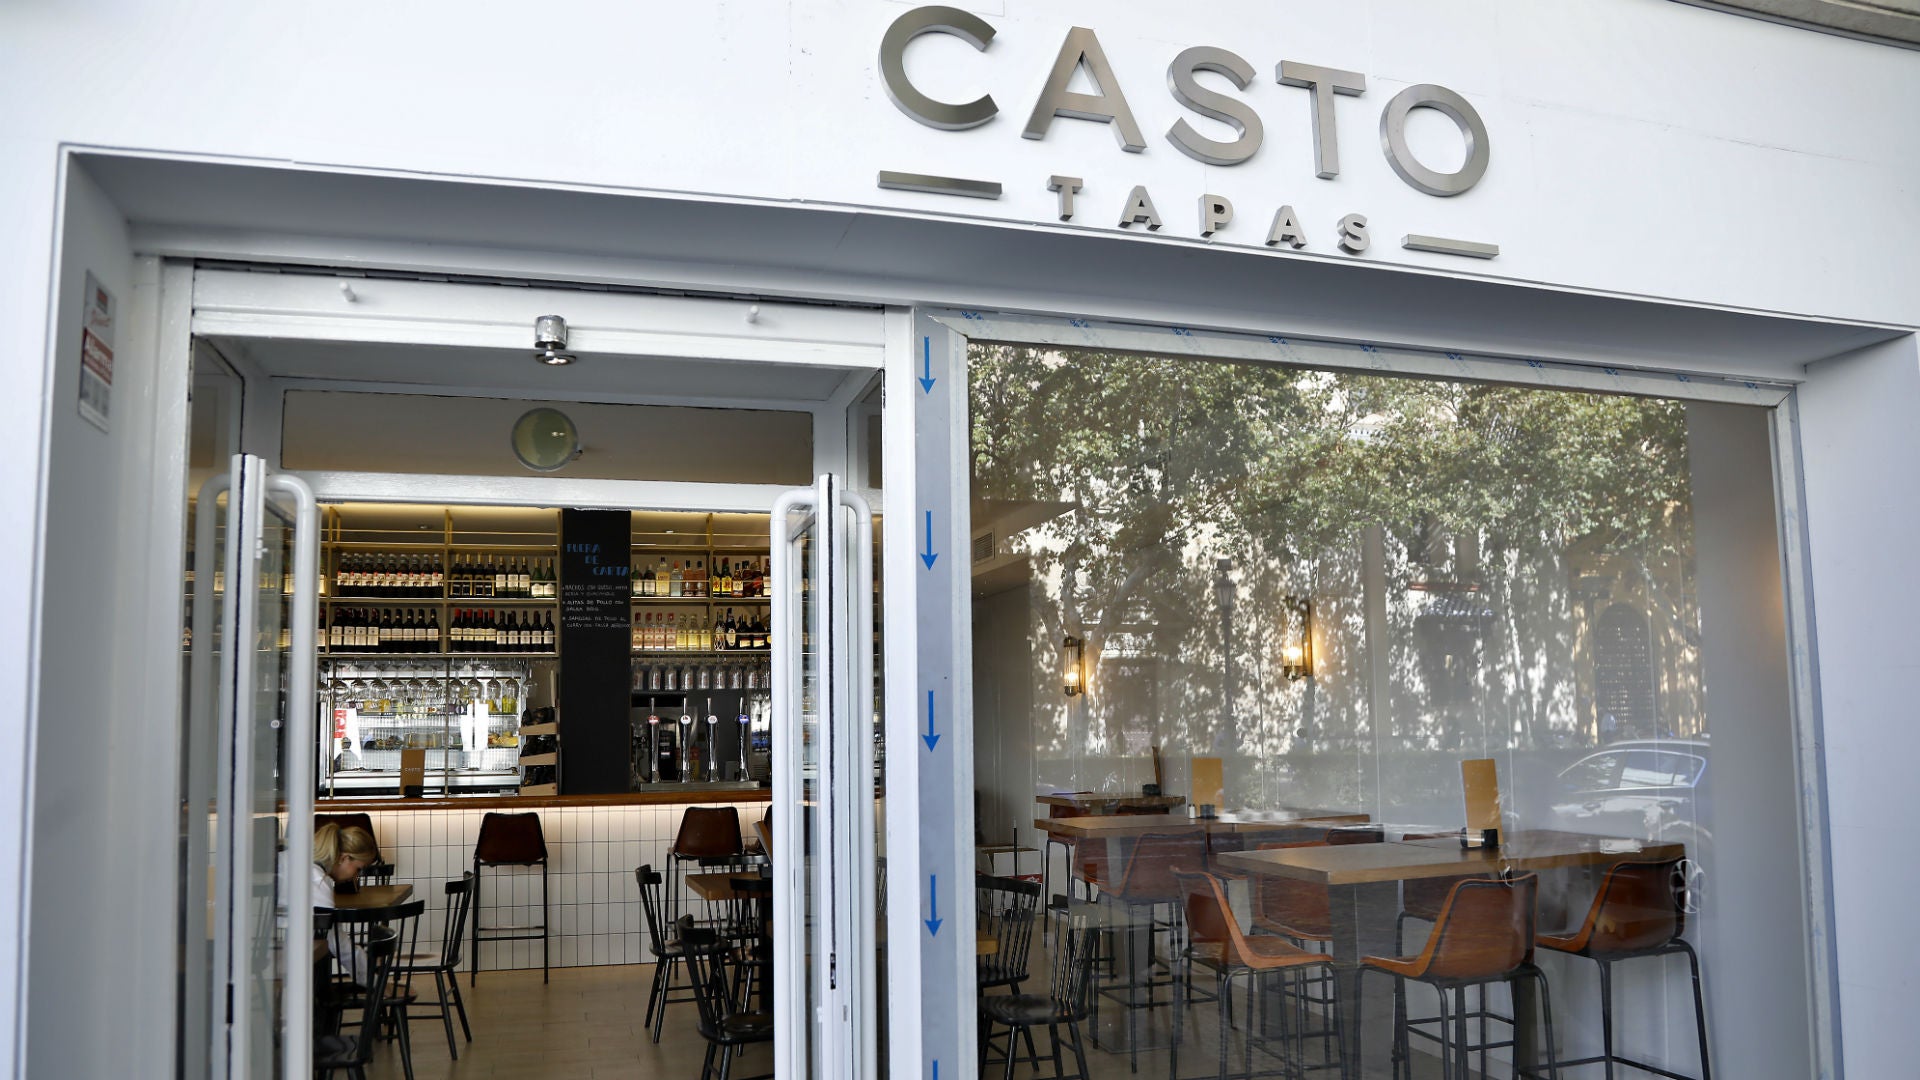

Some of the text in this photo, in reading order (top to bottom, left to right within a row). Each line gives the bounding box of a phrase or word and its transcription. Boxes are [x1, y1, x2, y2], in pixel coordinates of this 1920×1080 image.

[878, 5, 1490, 197] CASTO
[1046, 174, 1371, 256] TAPAS
[566, 543, 600, 552] FUERA
[585, 555, 599, 564] DE
[592, 566, 629, 576] CARTA
